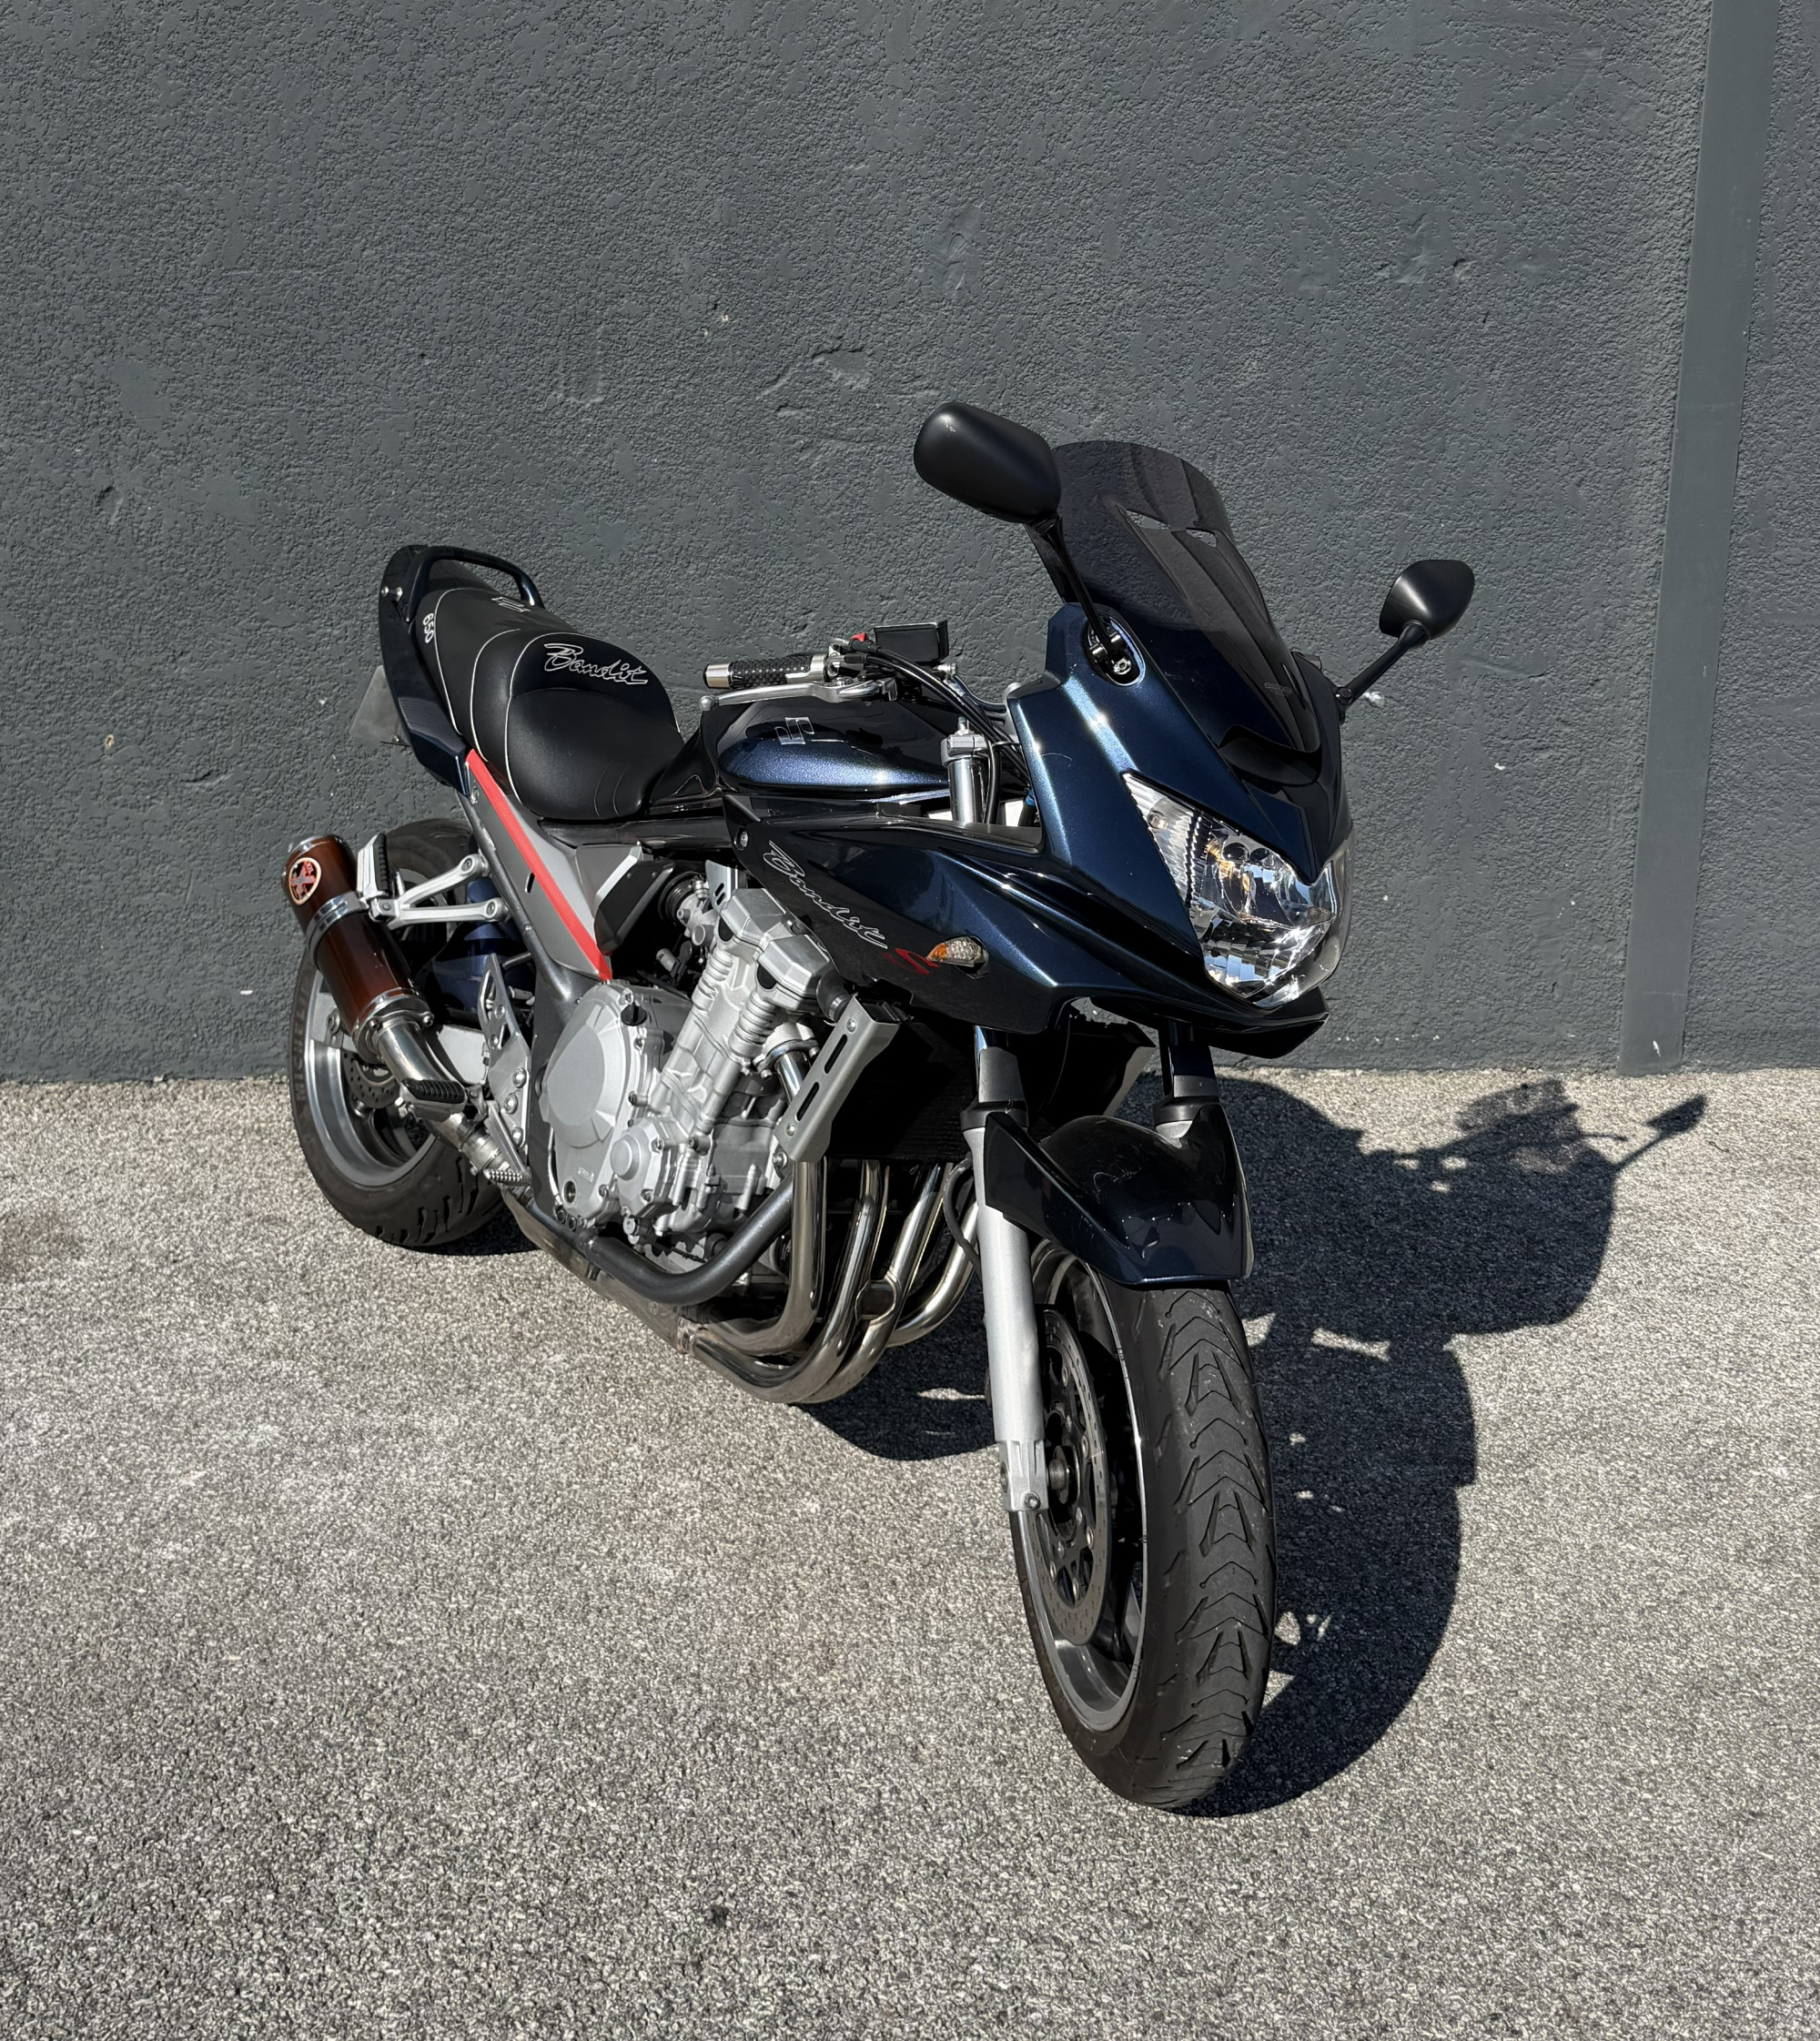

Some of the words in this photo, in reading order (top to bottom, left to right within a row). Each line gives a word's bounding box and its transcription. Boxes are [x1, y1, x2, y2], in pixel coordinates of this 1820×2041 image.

[422, 612, 435, 644] 650
[543, 642, 649, 684] Bandit
[763, 840, 888, 949] Bandit
